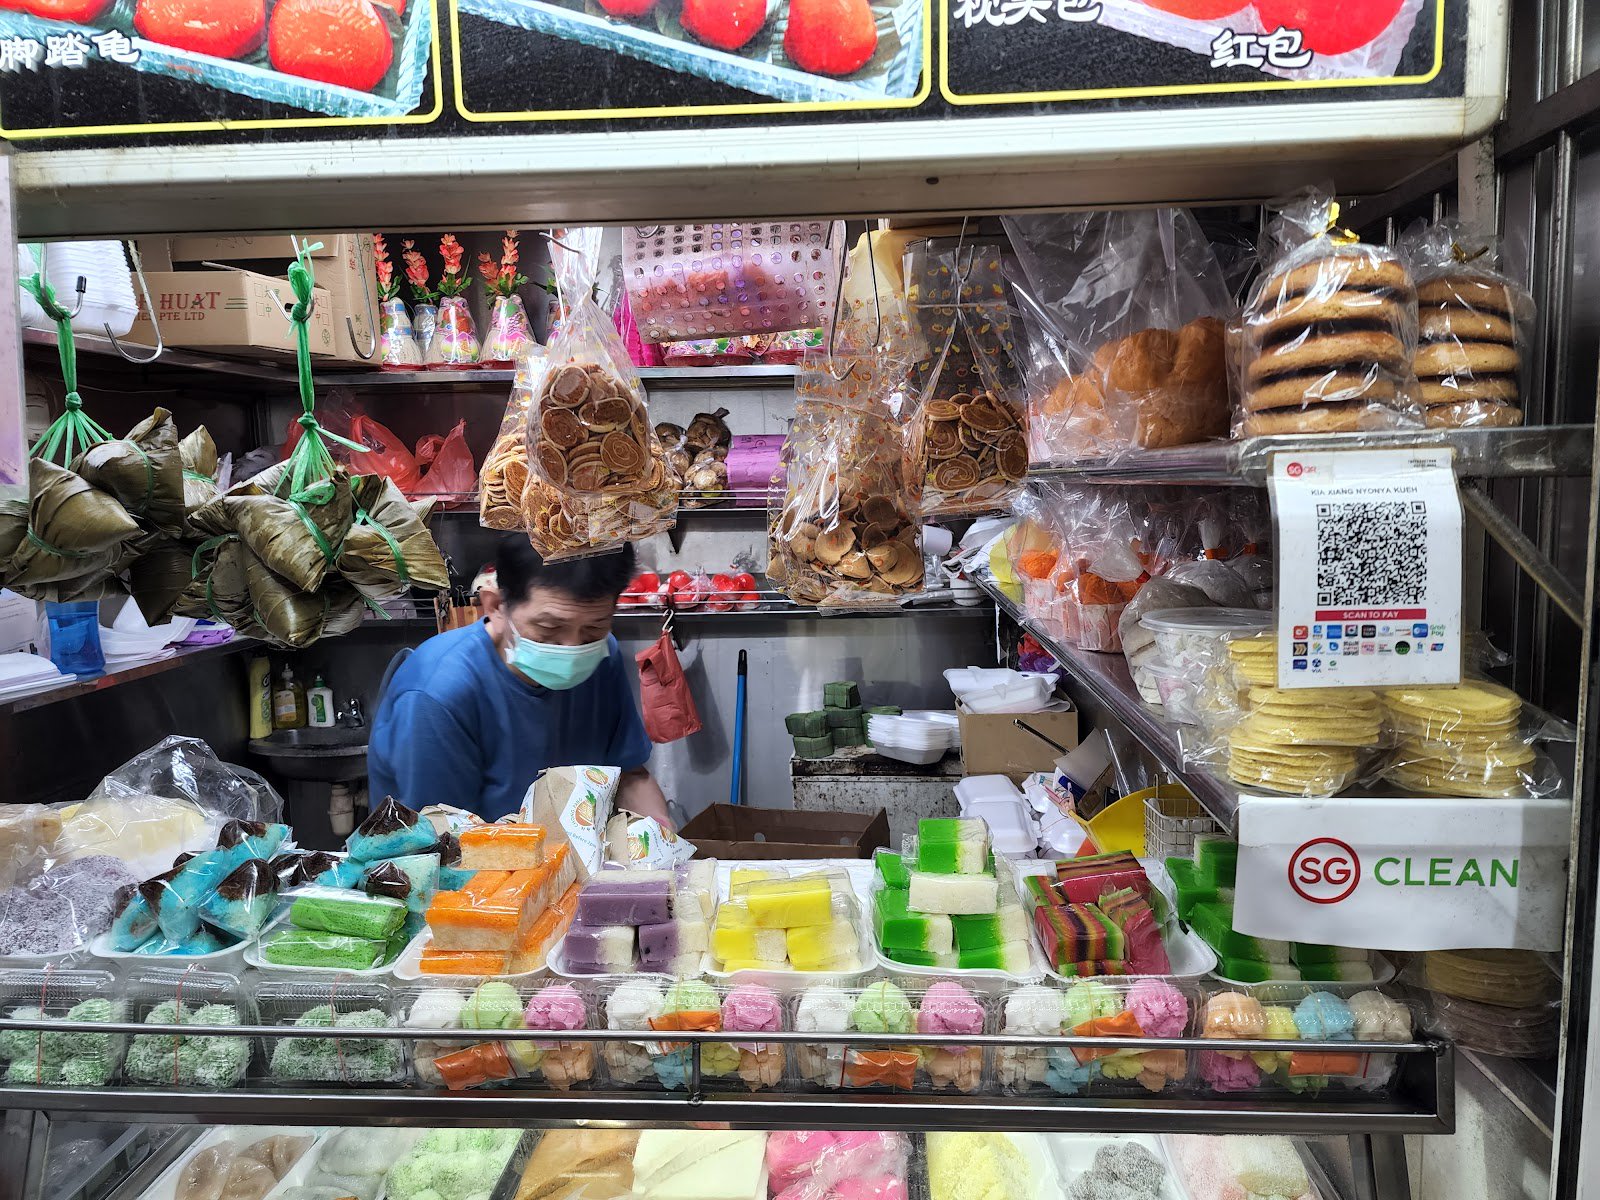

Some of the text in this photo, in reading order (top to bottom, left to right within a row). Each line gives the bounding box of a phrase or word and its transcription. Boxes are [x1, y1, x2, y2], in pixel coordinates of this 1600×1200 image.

[0, 30, 140, 69] 脚踏龟
[1210, 26, 1313, 68] 红包
[160, 291, 221, 310] HUAT
[160, 311, 180, 320] PTE
[184, 311, 205, 320] LTD
[1311, 486, 1418, 496] KIA XIANG NYONYA KUEH
[1343, 610, 1399, 619] SCAN TO PAY
[1298, 857, 1519, 887] SG CLEAN
